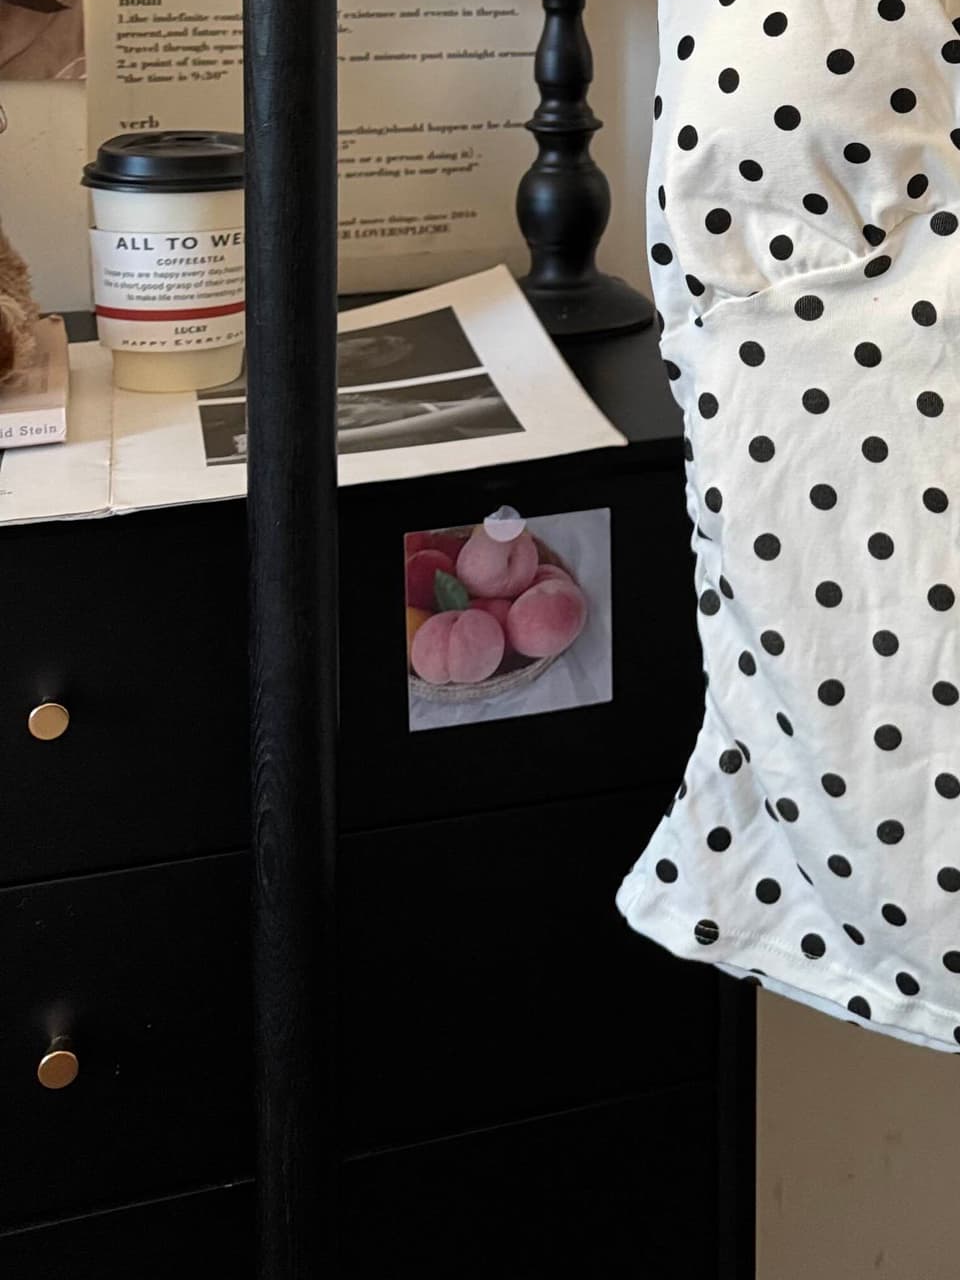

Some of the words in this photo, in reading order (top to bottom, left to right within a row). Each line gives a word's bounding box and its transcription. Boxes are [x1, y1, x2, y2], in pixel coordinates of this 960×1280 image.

[120, 115, 160, 129] verb
[116, 236, 155, 251] ALL
[166, 236, 199, 250] TO
[211, 232, 245, 248] WE
[156, 255, 226, 266] COFFEE&TEA
[20, 424, 57, 437] Stein
